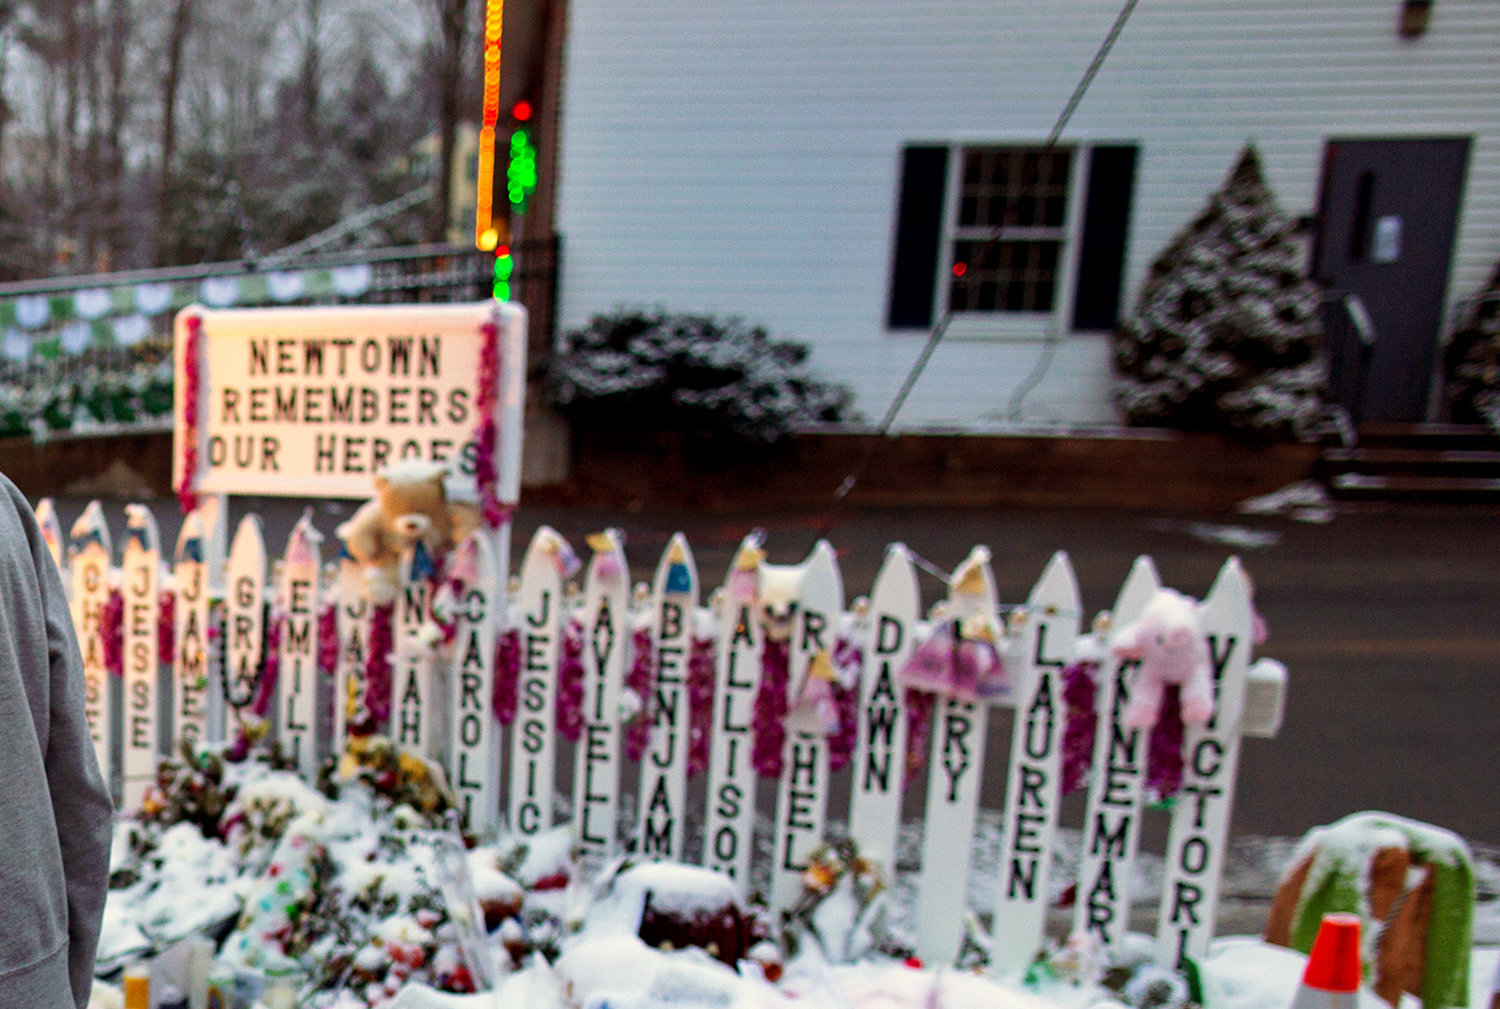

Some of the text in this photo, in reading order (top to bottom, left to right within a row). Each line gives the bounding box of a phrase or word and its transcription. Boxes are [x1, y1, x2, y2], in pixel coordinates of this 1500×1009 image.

[208, 435, 281, 471] OUR
[221, 385, 469, 424] REMEMBERS
[249, 337, 441, 377] NEWTOWN
[132, 566, 151, 749] JESSE
[400, 586, 425, 745] NAH
[518, 590, 551, 836] JESSIC
[581, 595, 614, 850] AVIELL
[646, 601, 683, 858] BENJAM
[711, 605, 753, 873] ALLISO
[784, 610, 827, 872] RHEL
[863, 614, 904, 794] DAWN
[1007, 624, 1065, 900] LAUREN
[1170, 634, 1237, 969] VICTORI
